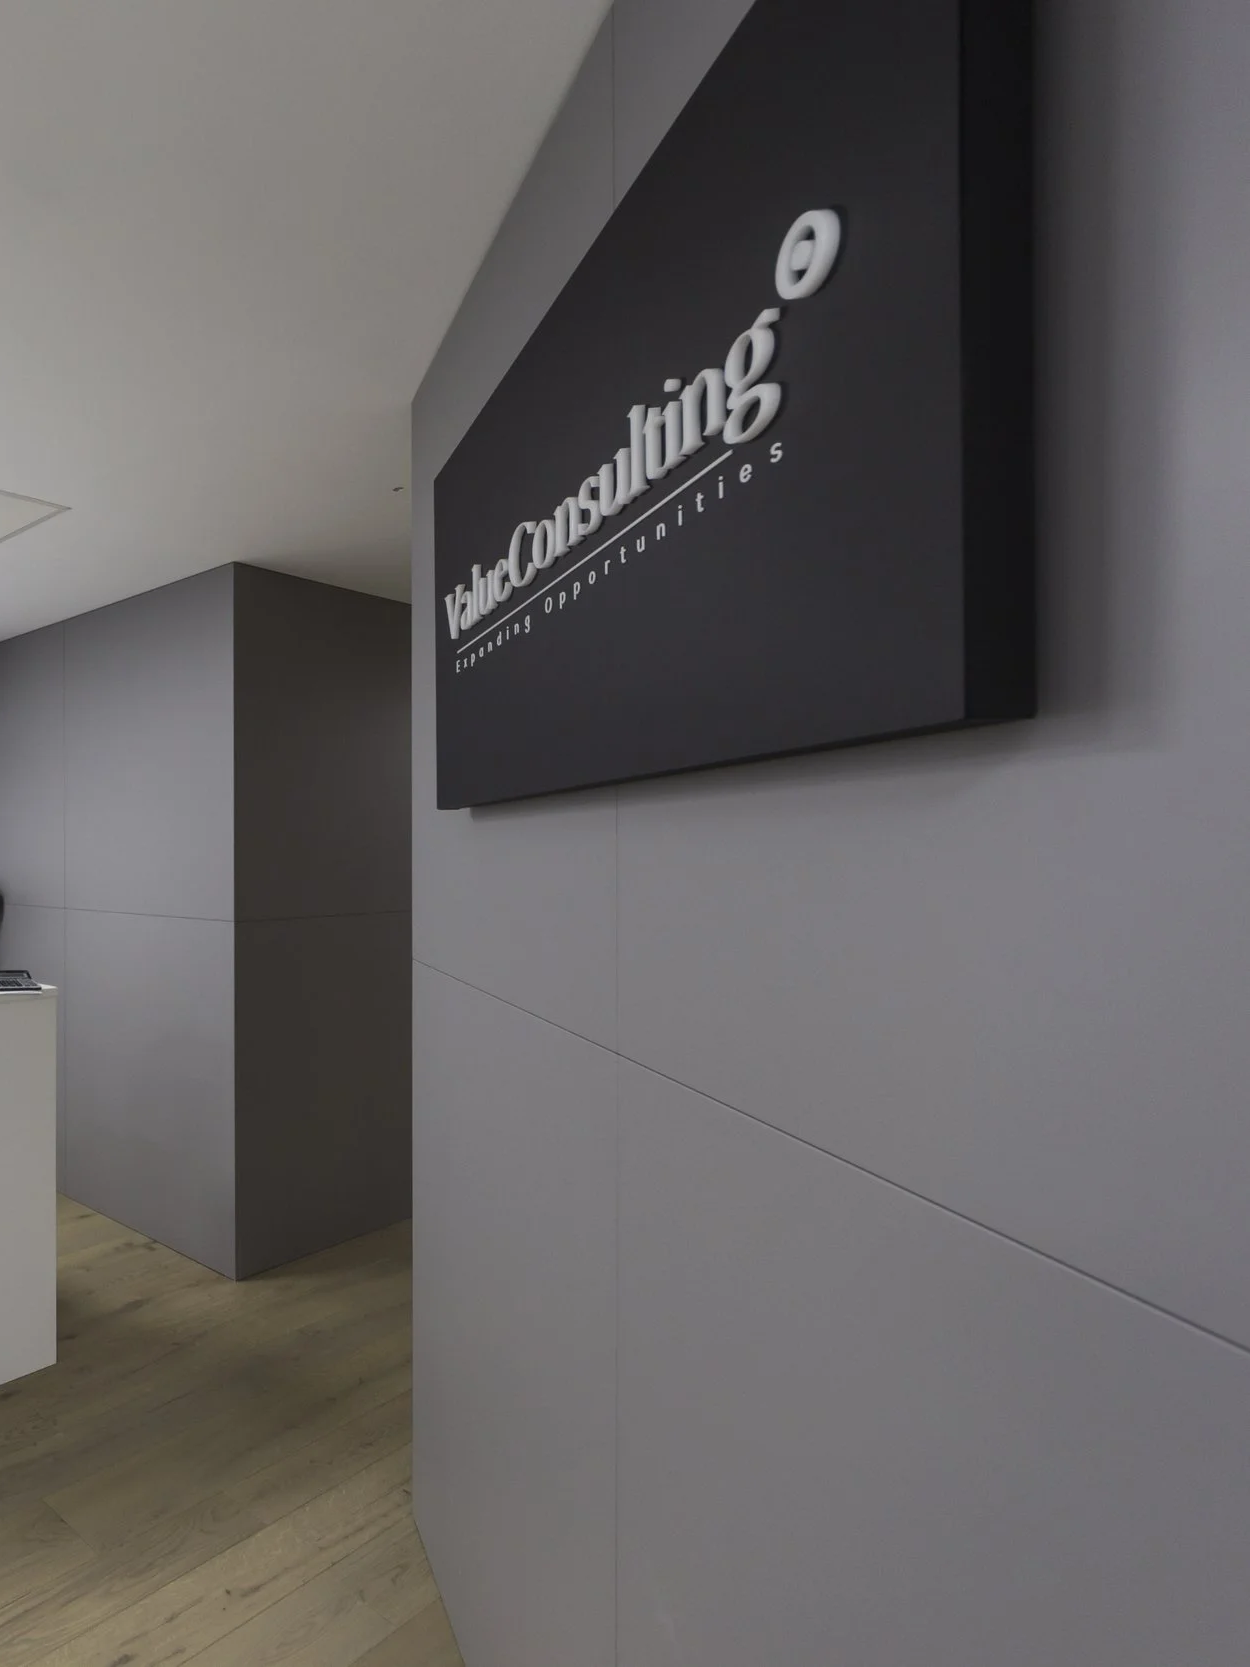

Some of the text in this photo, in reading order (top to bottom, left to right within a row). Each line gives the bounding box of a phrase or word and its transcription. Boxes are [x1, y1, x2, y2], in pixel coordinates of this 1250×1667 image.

[444, 307, 782, 640] ValueConsulting
[455, 441, 784, 674] Expanding Opportunities
